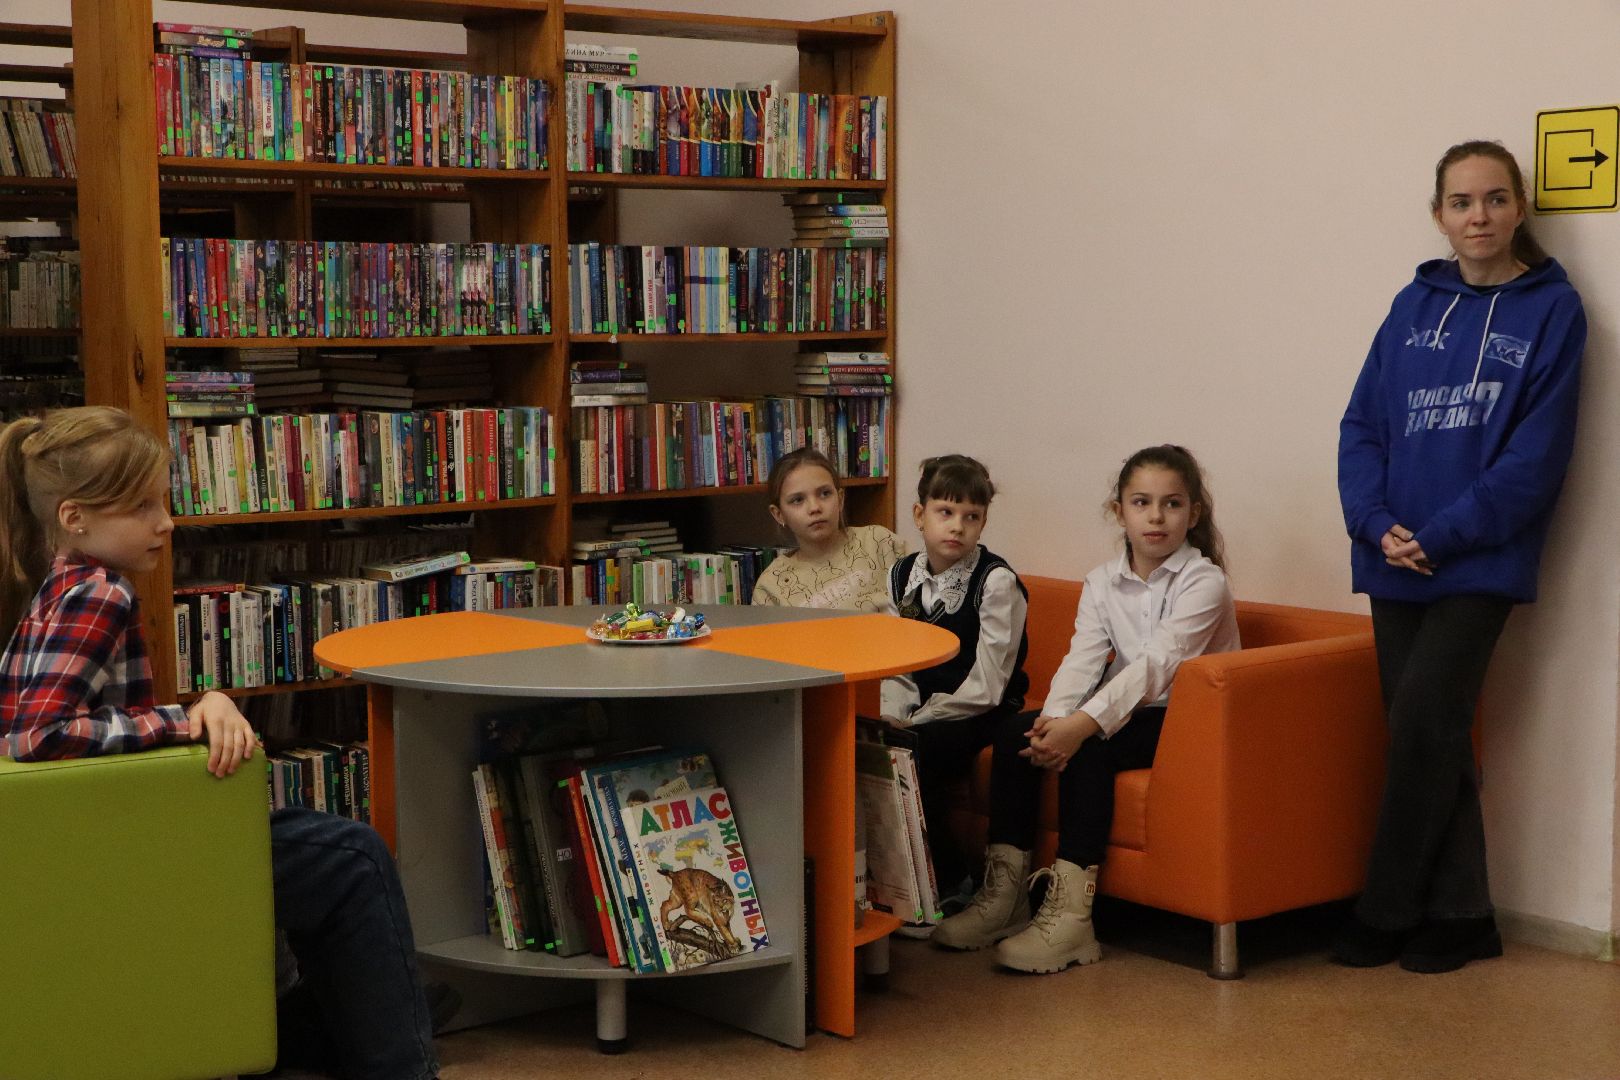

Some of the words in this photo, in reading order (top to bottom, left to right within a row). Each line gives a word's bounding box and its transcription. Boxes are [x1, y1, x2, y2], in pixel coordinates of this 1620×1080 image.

[640, 792, 732, 837] АТЛАС
[632, 843, 655, 906] ЖИВОТНЫХ
[717, 819, 769, 952] ЖИВОТНЫХ
